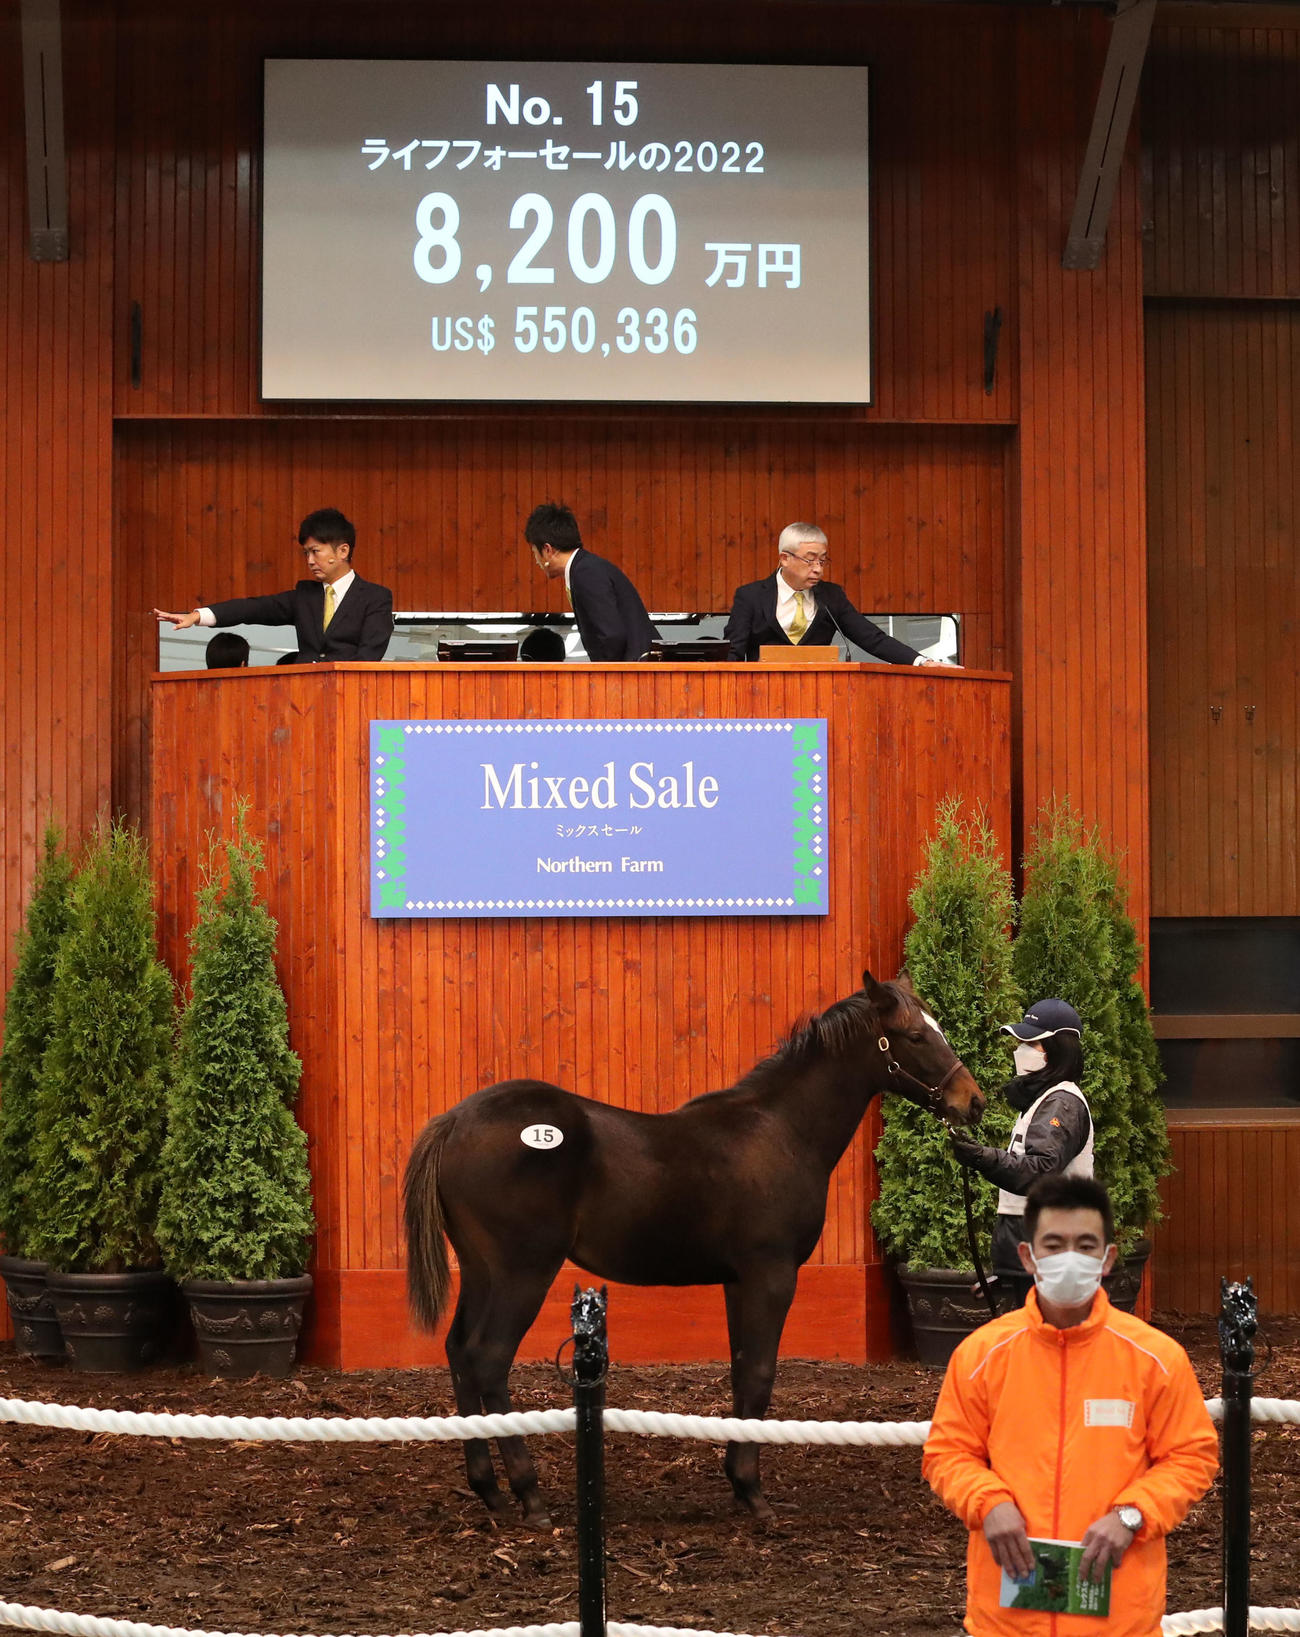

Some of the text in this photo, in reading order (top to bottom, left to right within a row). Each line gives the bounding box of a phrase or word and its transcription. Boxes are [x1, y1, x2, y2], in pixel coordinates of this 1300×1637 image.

[486, 80, 638, 126] No. 15
[361, 138, 764, 173] ライフフォーセールの2022
[413, 191, 801, 292] 8,200 万円
[431, 306, 698, 358] US$ 550,336
[480, 761, 719, 810] Mixed Sale
[556, 823, 643, 838] ミックスセール
[536, 856, 664, 873] Northern Farm
[532, 1128, 554, 1143] 15
